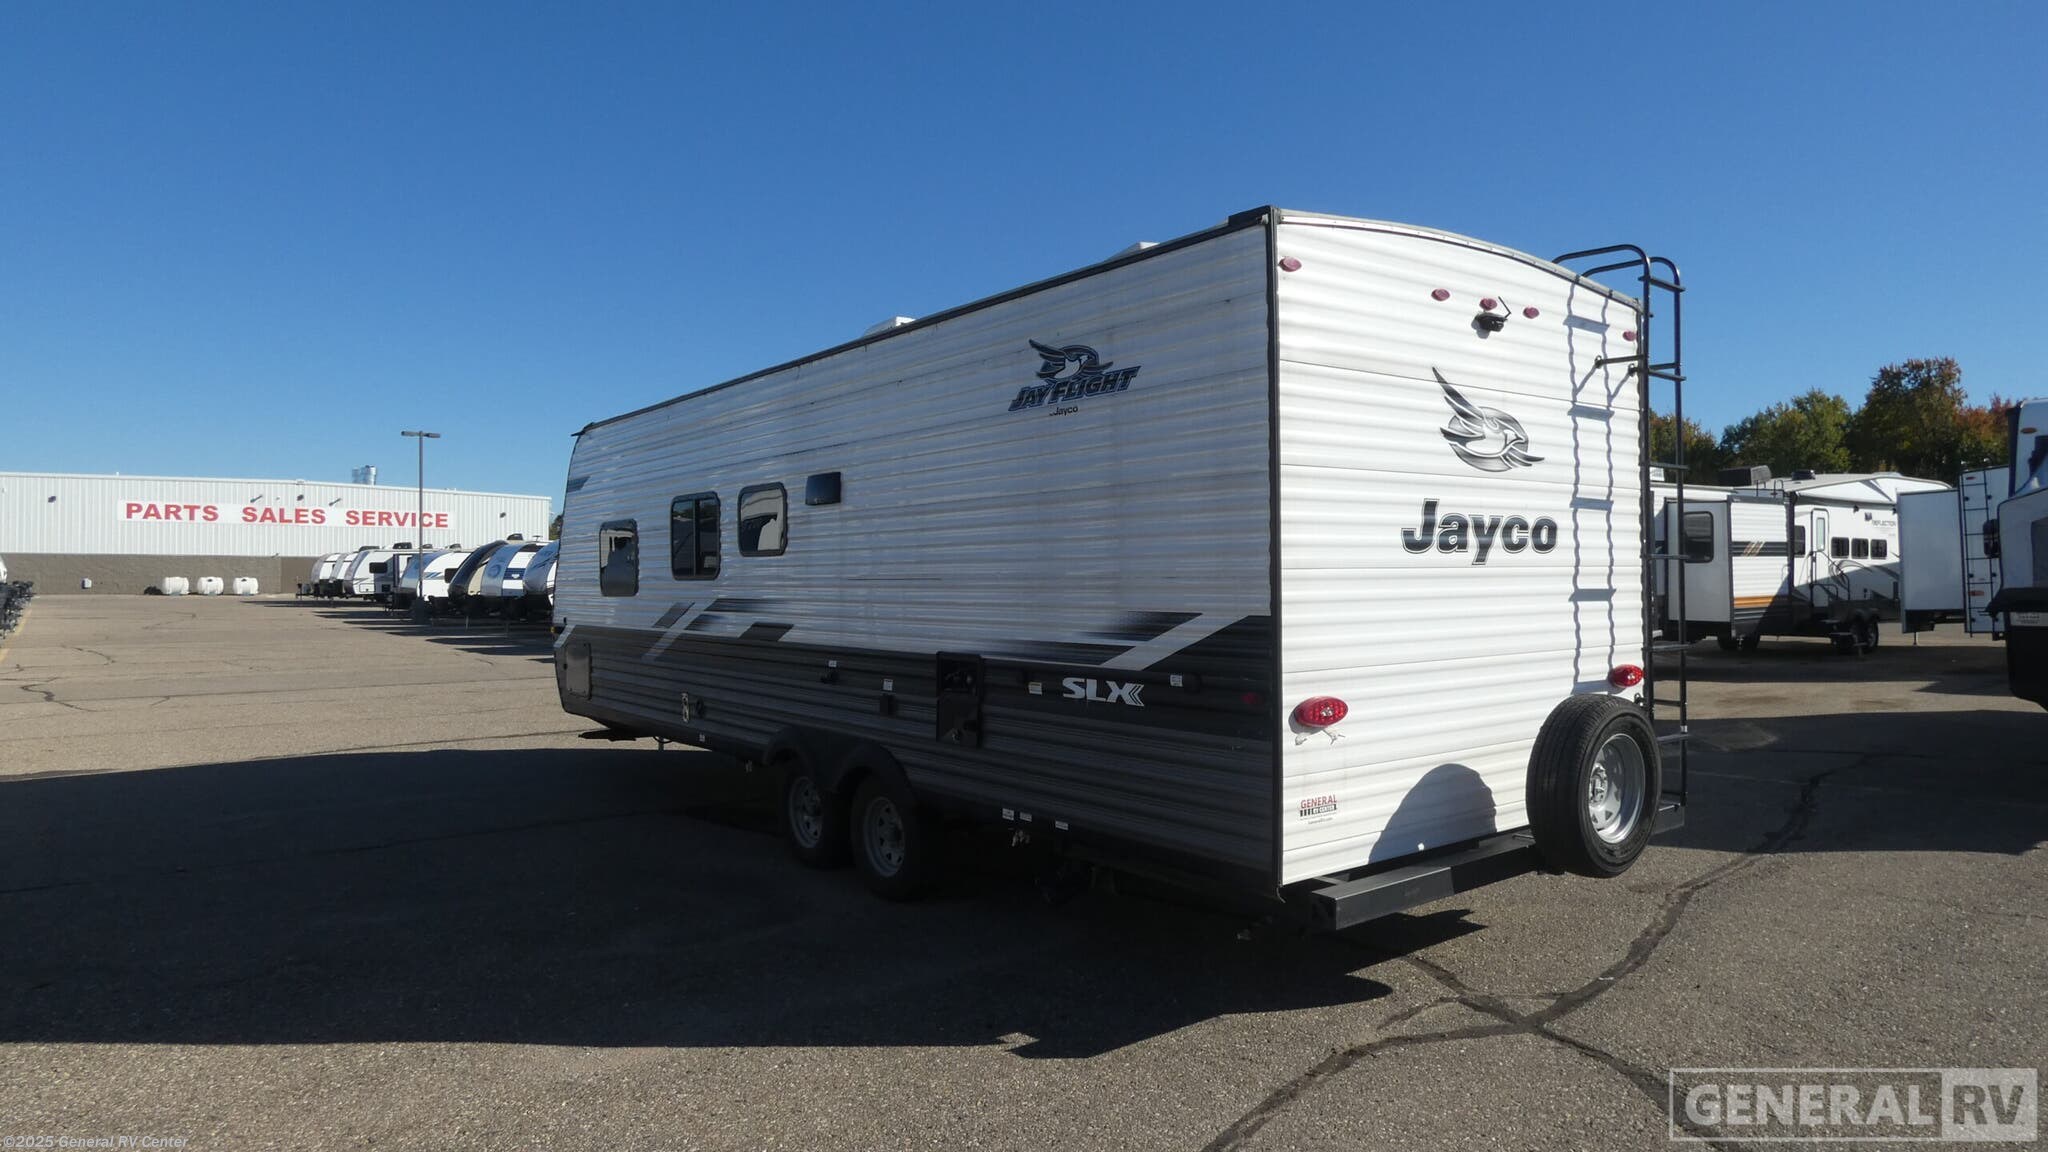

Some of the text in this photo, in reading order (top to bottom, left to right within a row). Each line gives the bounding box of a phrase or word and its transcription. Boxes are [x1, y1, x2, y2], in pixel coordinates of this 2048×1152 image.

[1008, 366, 1140, 411] JAY FLIGHT
[1049, 405, 1078, 416] Jayco
[126, 502, 449, 528] PARTS SALES SERVICE
[1400, 497, 1558, 566] Jayco
[1062, 677, 1145, 707] SLX
[1300, 794, 1337, 809] GENERAL
